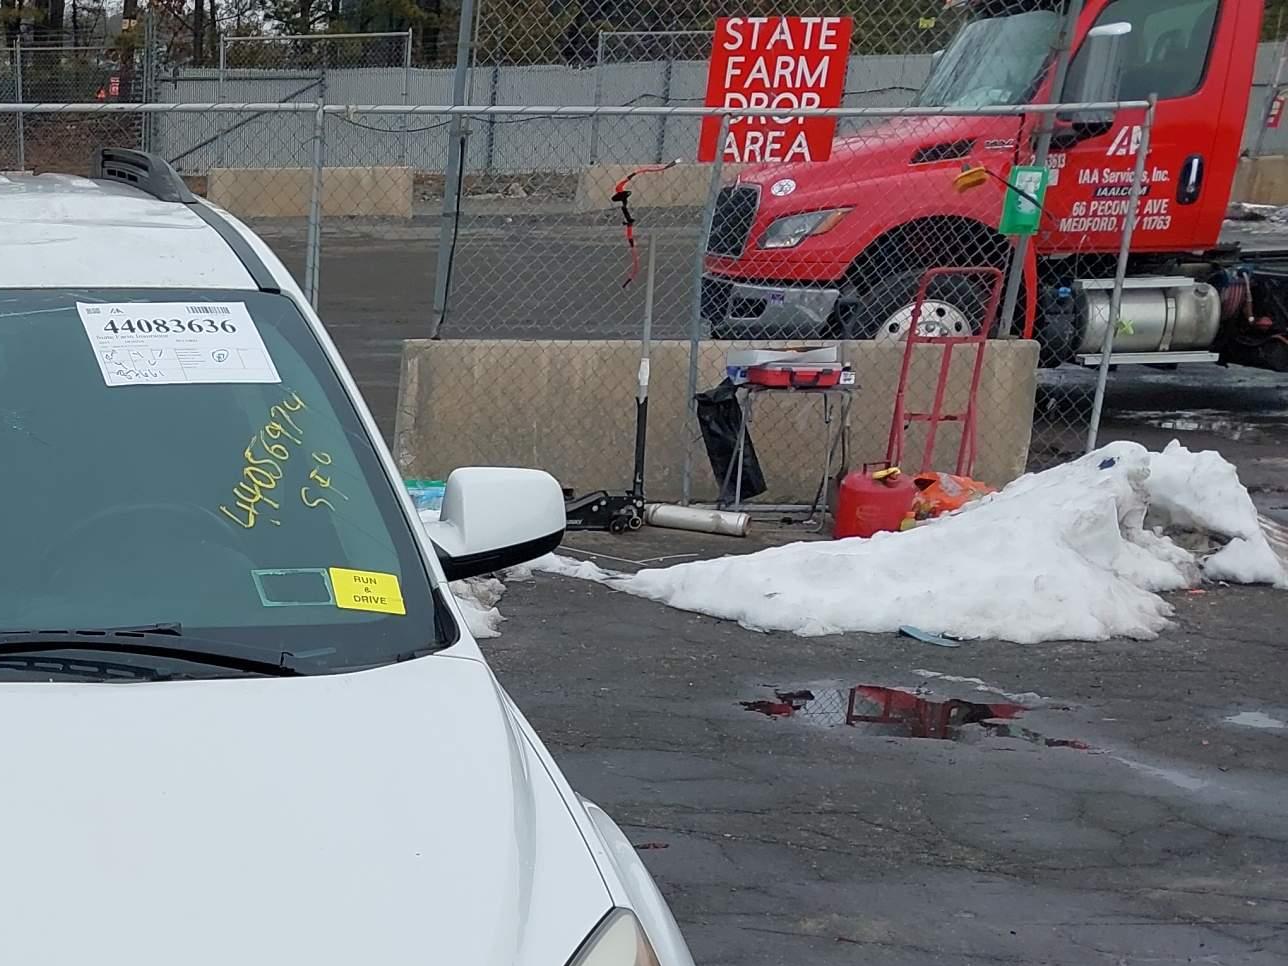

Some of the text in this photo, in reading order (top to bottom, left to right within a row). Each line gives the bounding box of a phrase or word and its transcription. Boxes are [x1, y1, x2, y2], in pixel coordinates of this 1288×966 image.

[723, 17, 840, 50] STATE
[724, 55, 830, 89] FARM
[724, 92, 821, 124] DROP
[723, 131, 811, 162] AREA
[1078, 166, 1170, 184] IAA Servics, Inc.
[1096, 186, 1148, 197] IAAI.CM
[1072, 199, 1169, 216] 66 PECON AVE
[1059, 217, 1118, 233] MEDFORD,
[104, 318, 237, 334] 44083636
[219, 390, 307, 528] 44056974
[353, 575, 377, 584] RUN
[353, 595, 388, 605] DRIVE
